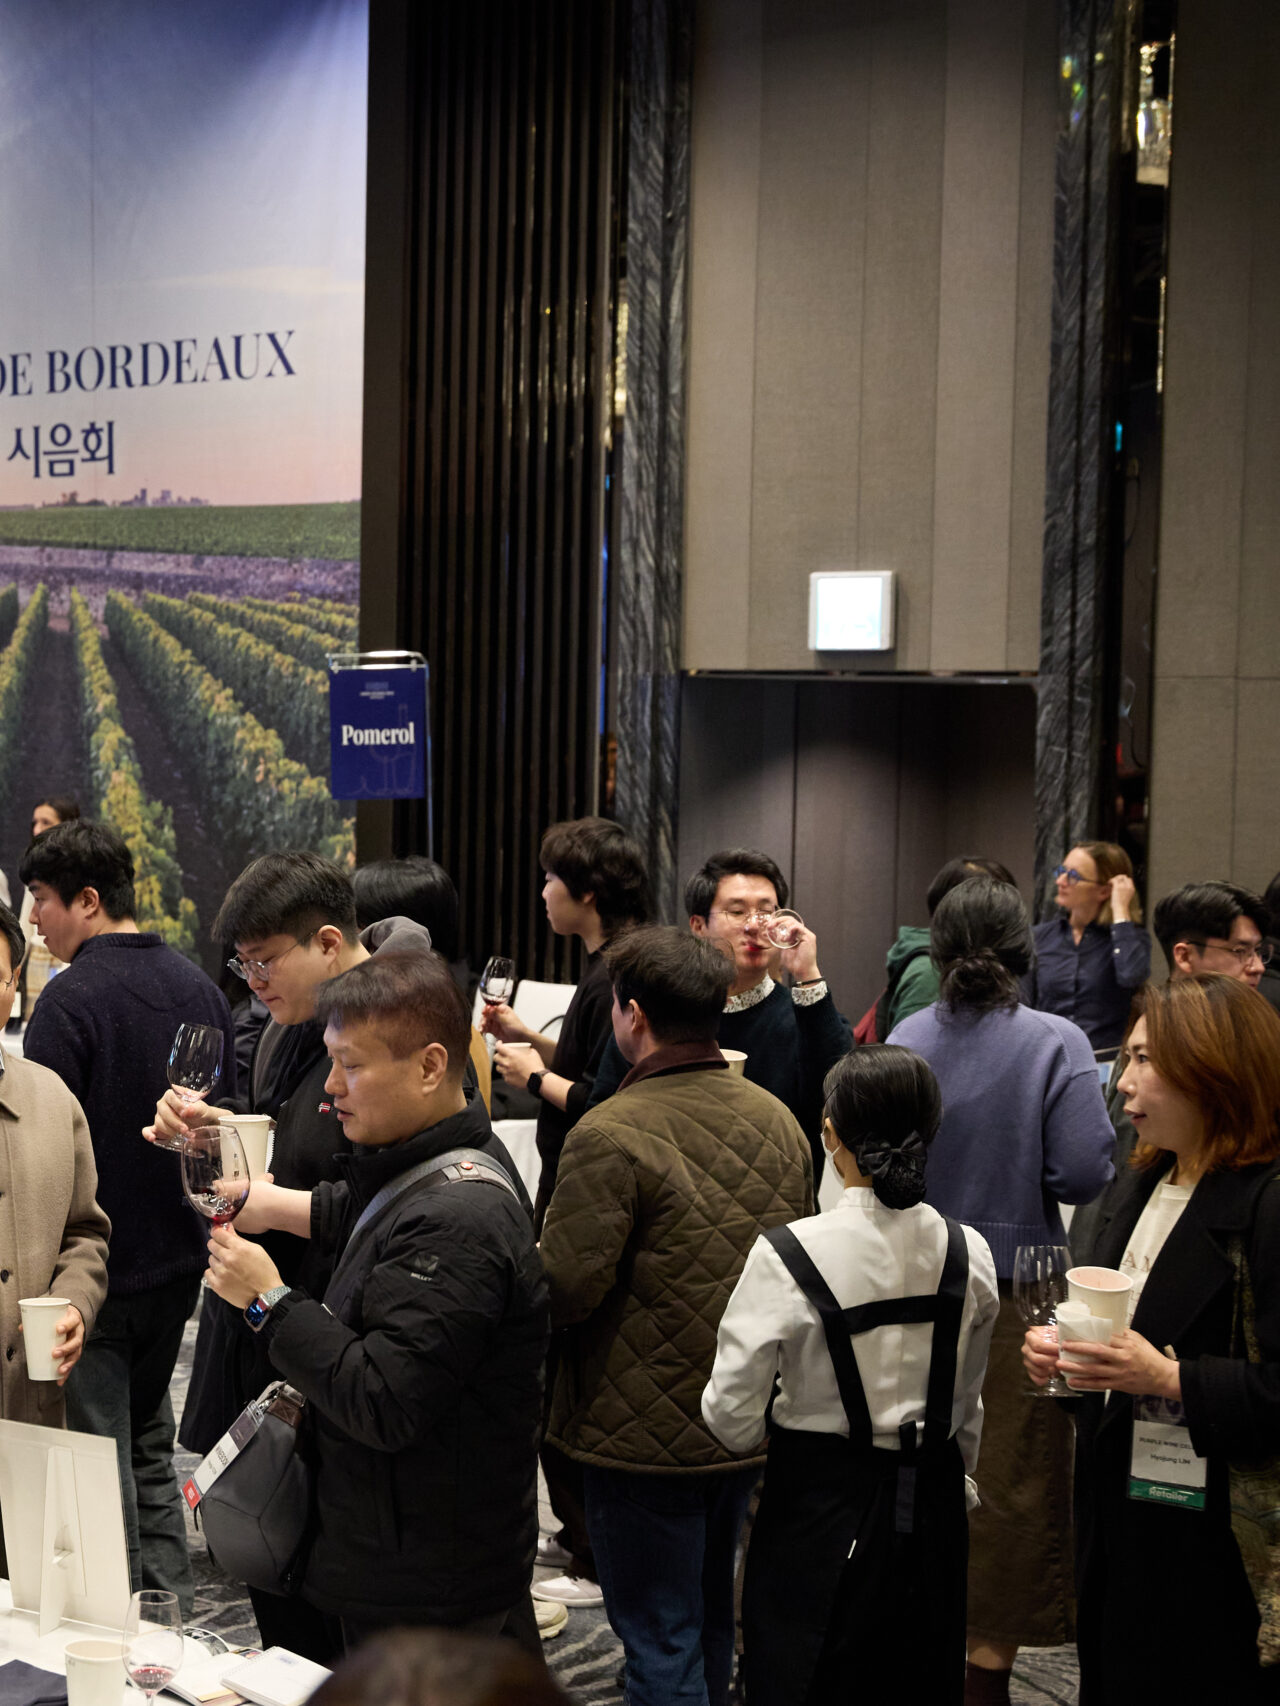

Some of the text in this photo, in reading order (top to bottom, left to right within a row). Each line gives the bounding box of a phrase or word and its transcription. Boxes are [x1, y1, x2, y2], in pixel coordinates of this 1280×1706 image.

[46, 330, 297, 394] BORDEAUX
[7, 420, 116, 479] 시음회
[341, 721, 415, 746] Pomerol
[1148, 1487, 1189, 1502] Retailer
